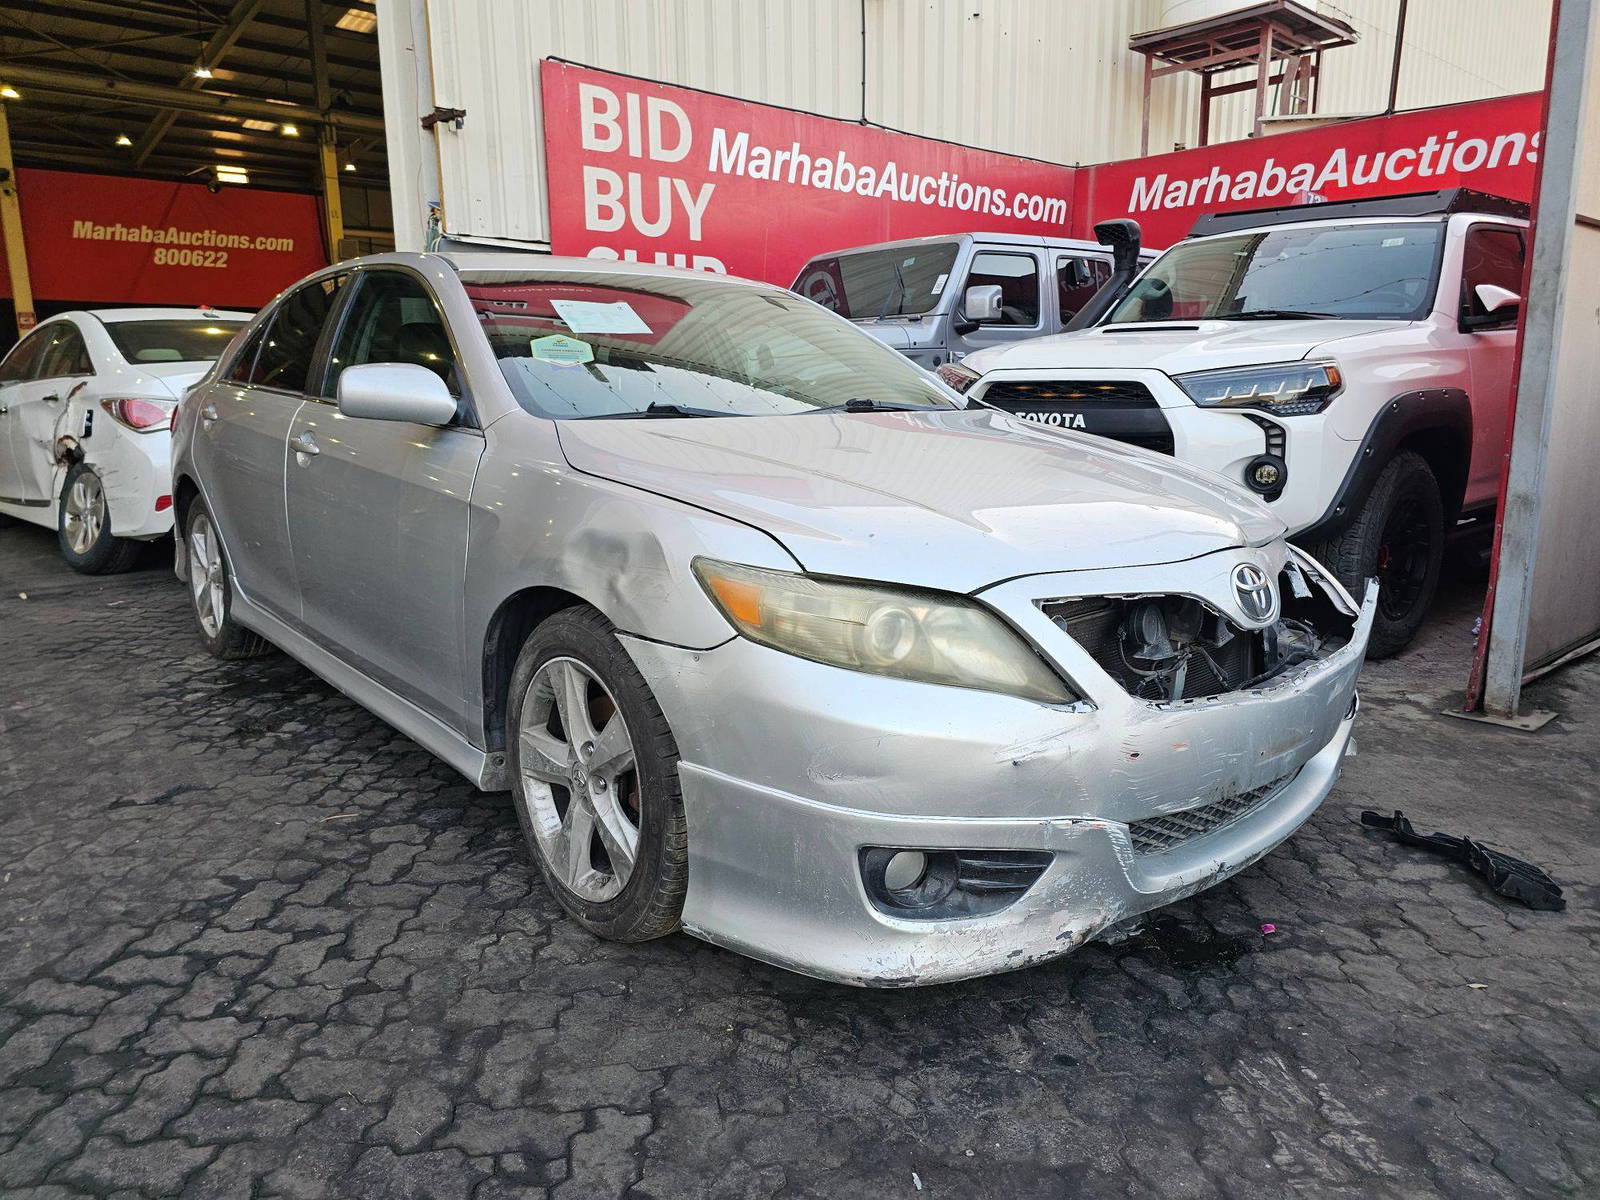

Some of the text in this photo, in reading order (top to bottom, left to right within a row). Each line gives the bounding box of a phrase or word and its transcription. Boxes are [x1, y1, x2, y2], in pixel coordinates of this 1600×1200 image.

[579, 82, 692, 163] BID
[583, 165, 716, 242] BUY
[708, 127, 1067, 225] MarhabaAuctions.com
[73, 220, 294, 251] MarhabaAuctions.com
[154, 248, 228, 268] 800622
